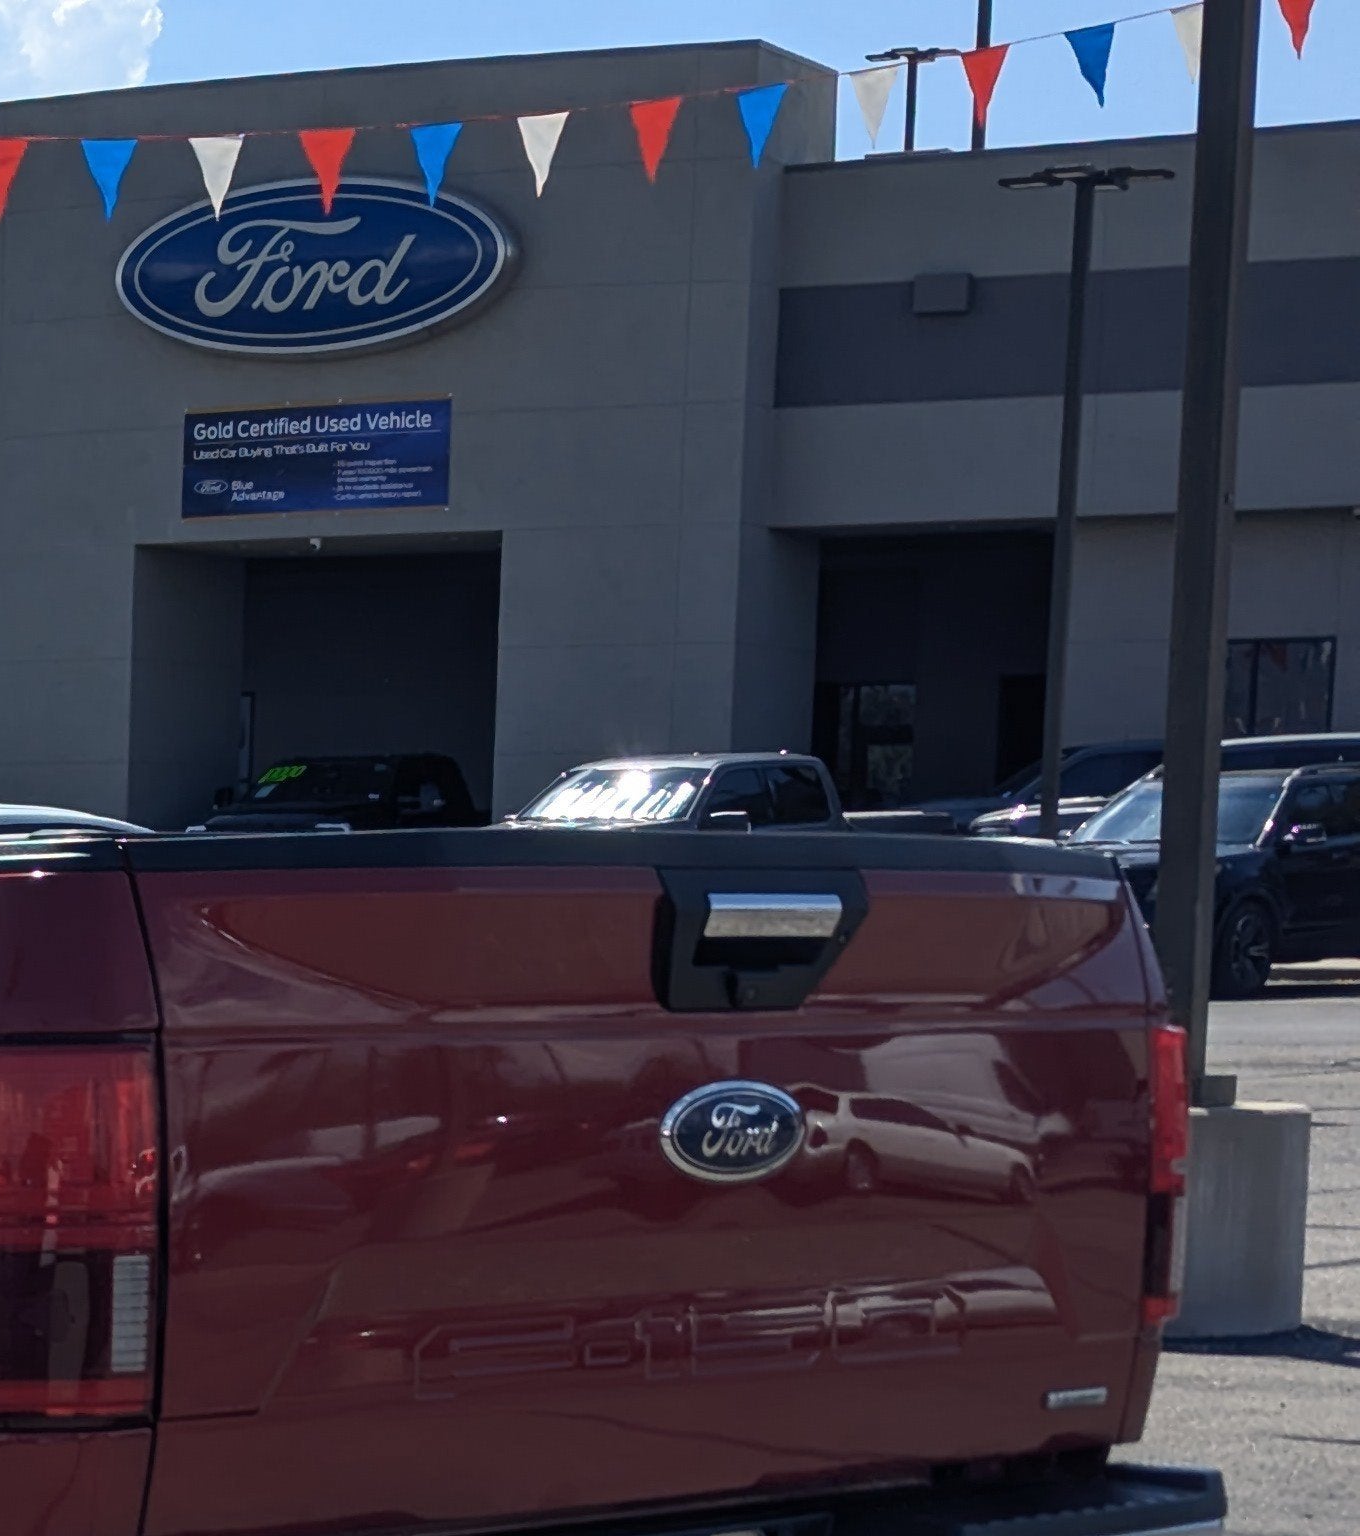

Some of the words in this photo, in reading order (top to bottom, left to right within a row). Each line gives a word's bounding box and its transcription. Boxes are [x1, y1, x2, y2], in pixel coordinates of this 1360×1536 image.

[194, 216, 416, 318] Ford
[193, 421, 233, 441] Gold
[237, 415, 311, 438] Certified
[315, 413, 362, 433] Used
[366, 410, 432, 431] Vehicle
[193, 450, 219, 461] Used
[220, 448, 236, 459] Car
[238, 446, 273, 459] Buying
[273, 444, 305, 455] That's
[306, 443, 329, 453] Built
[330, 442, 347, 452] For
[231, 480, 254, 491] Blue
[231, 490, 285, 501] Advantage
[701, 1102, 779, 1158] Ford
